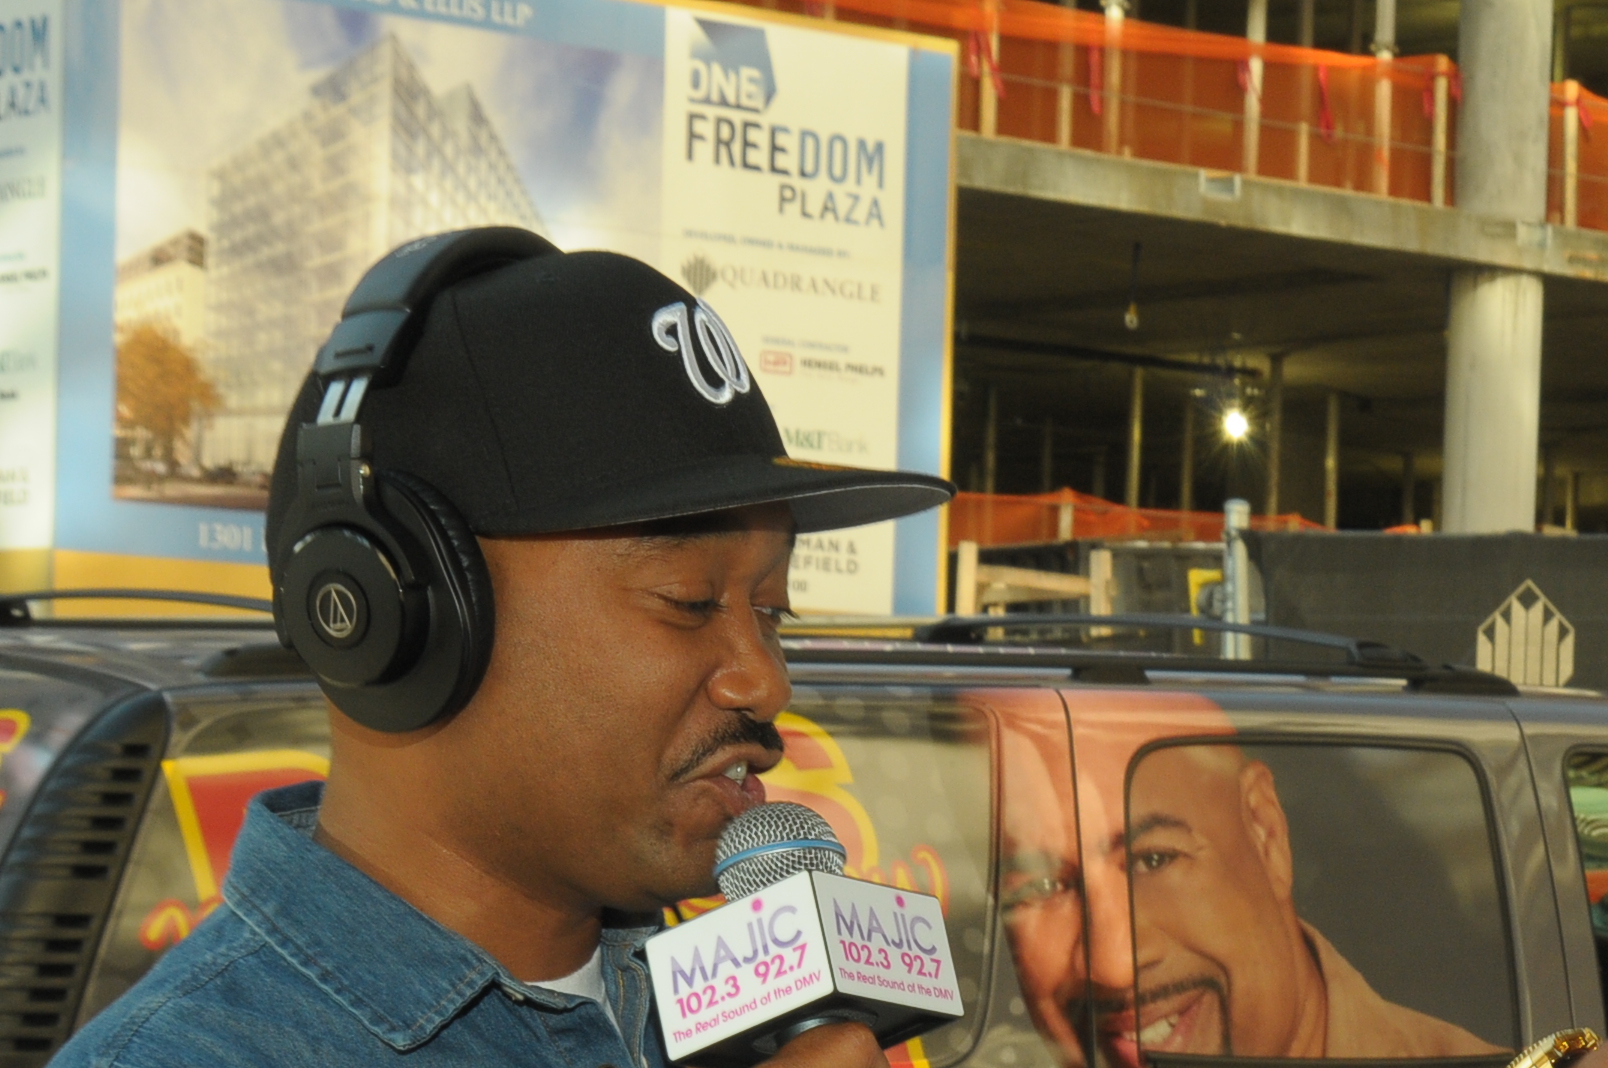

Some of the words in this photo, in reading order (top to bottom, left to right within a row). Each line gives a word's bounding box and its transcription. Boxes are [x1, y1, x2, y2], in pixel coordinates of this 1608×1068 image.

[0, 81, 51, 120] AZA
[688, 58, 764, 107] ONE
[685, 111, 886, 190] FREEDOM
[778, 183, 886, 229] PLAZA
[720, 263, 882, 303] QUADRANGLE
[800, 357, 841, 372] HENSEL
[844, 362, 885, 377] PHELPS
[199, 521, 253, 552] 1301
[671, 897, 803, 996] MAJIC
[833, 894, 938, 956] MAJIC
[676, 975, 741, 1019] 102.3
[754, 942, 808, 985] 92.7
[839, 939, 892, 970] 102.3
[900, 951, 942, 980] 92.7
[673, 1027, 693, 1043] The
[695, 1013, 720, 1034] Real
[722, 998, 758, 1023] Sound
[760, 991, 772, 1006] of
[774, 984, 793, 1000] the
[794, 969, 821, 991] DMV
[839, 967, 855, 981] The
[857, 971, 876, 986] Real
[878, 975, 905, 992] Sound
[907, 983, 917, 992] of
[918, 983, 932, 997] the
[933, 986, 954, 1001] DMV
